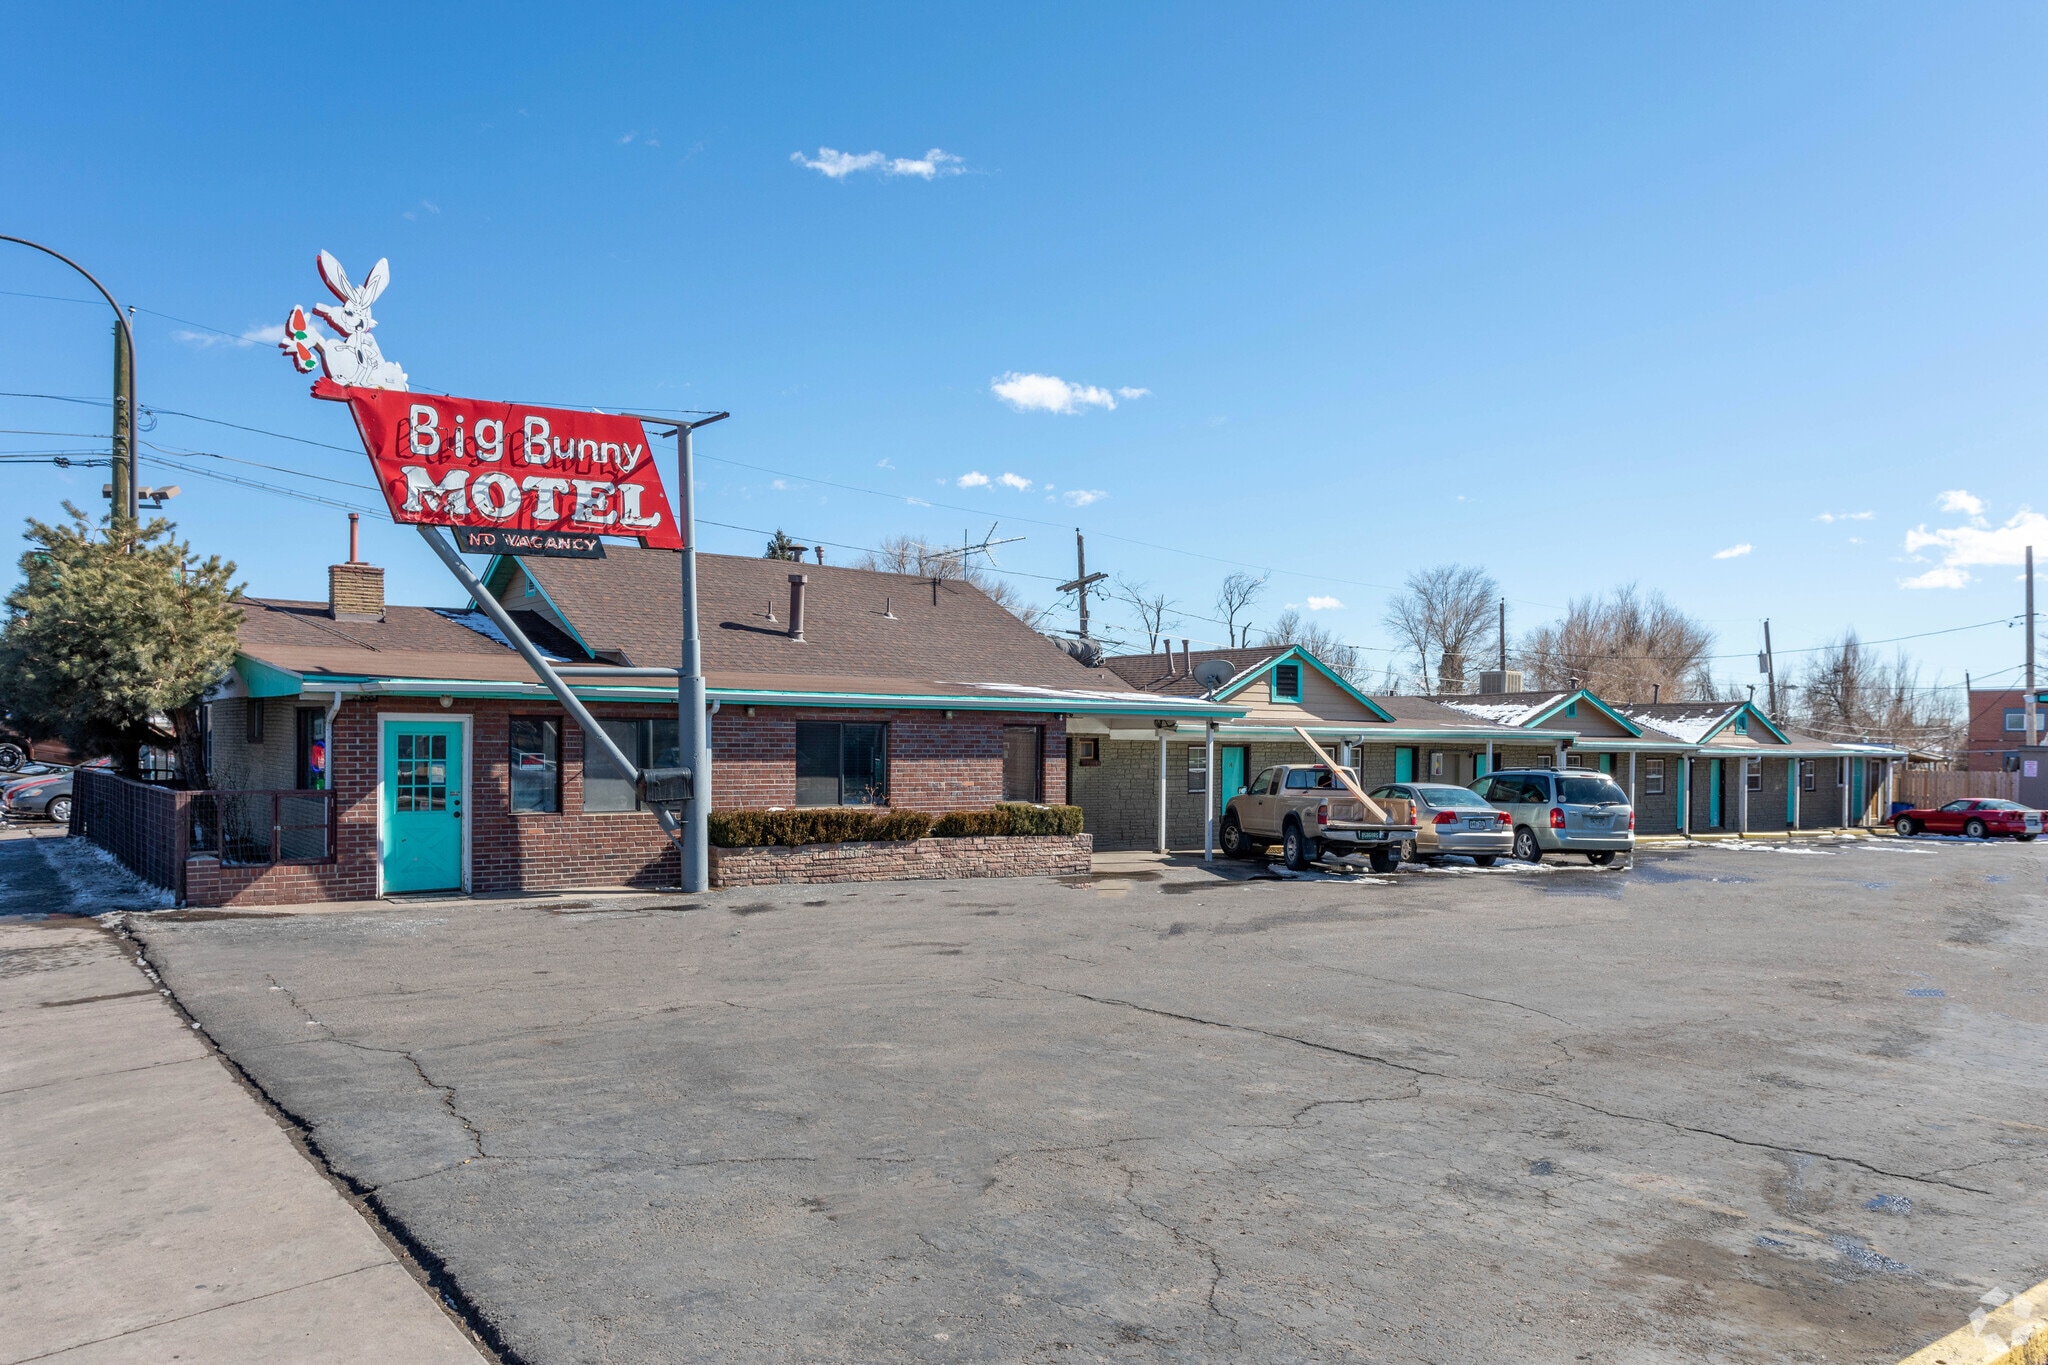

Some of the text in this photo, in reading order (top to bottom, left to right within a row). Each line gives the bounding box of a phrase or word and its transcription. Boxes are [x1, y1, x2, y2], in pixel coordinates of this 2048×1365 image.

[409, 404, 643, 473] Big Bunny
[401, 465, 661, 527] MOTEL
[468, 533, 598, 551] NO VACANCY
